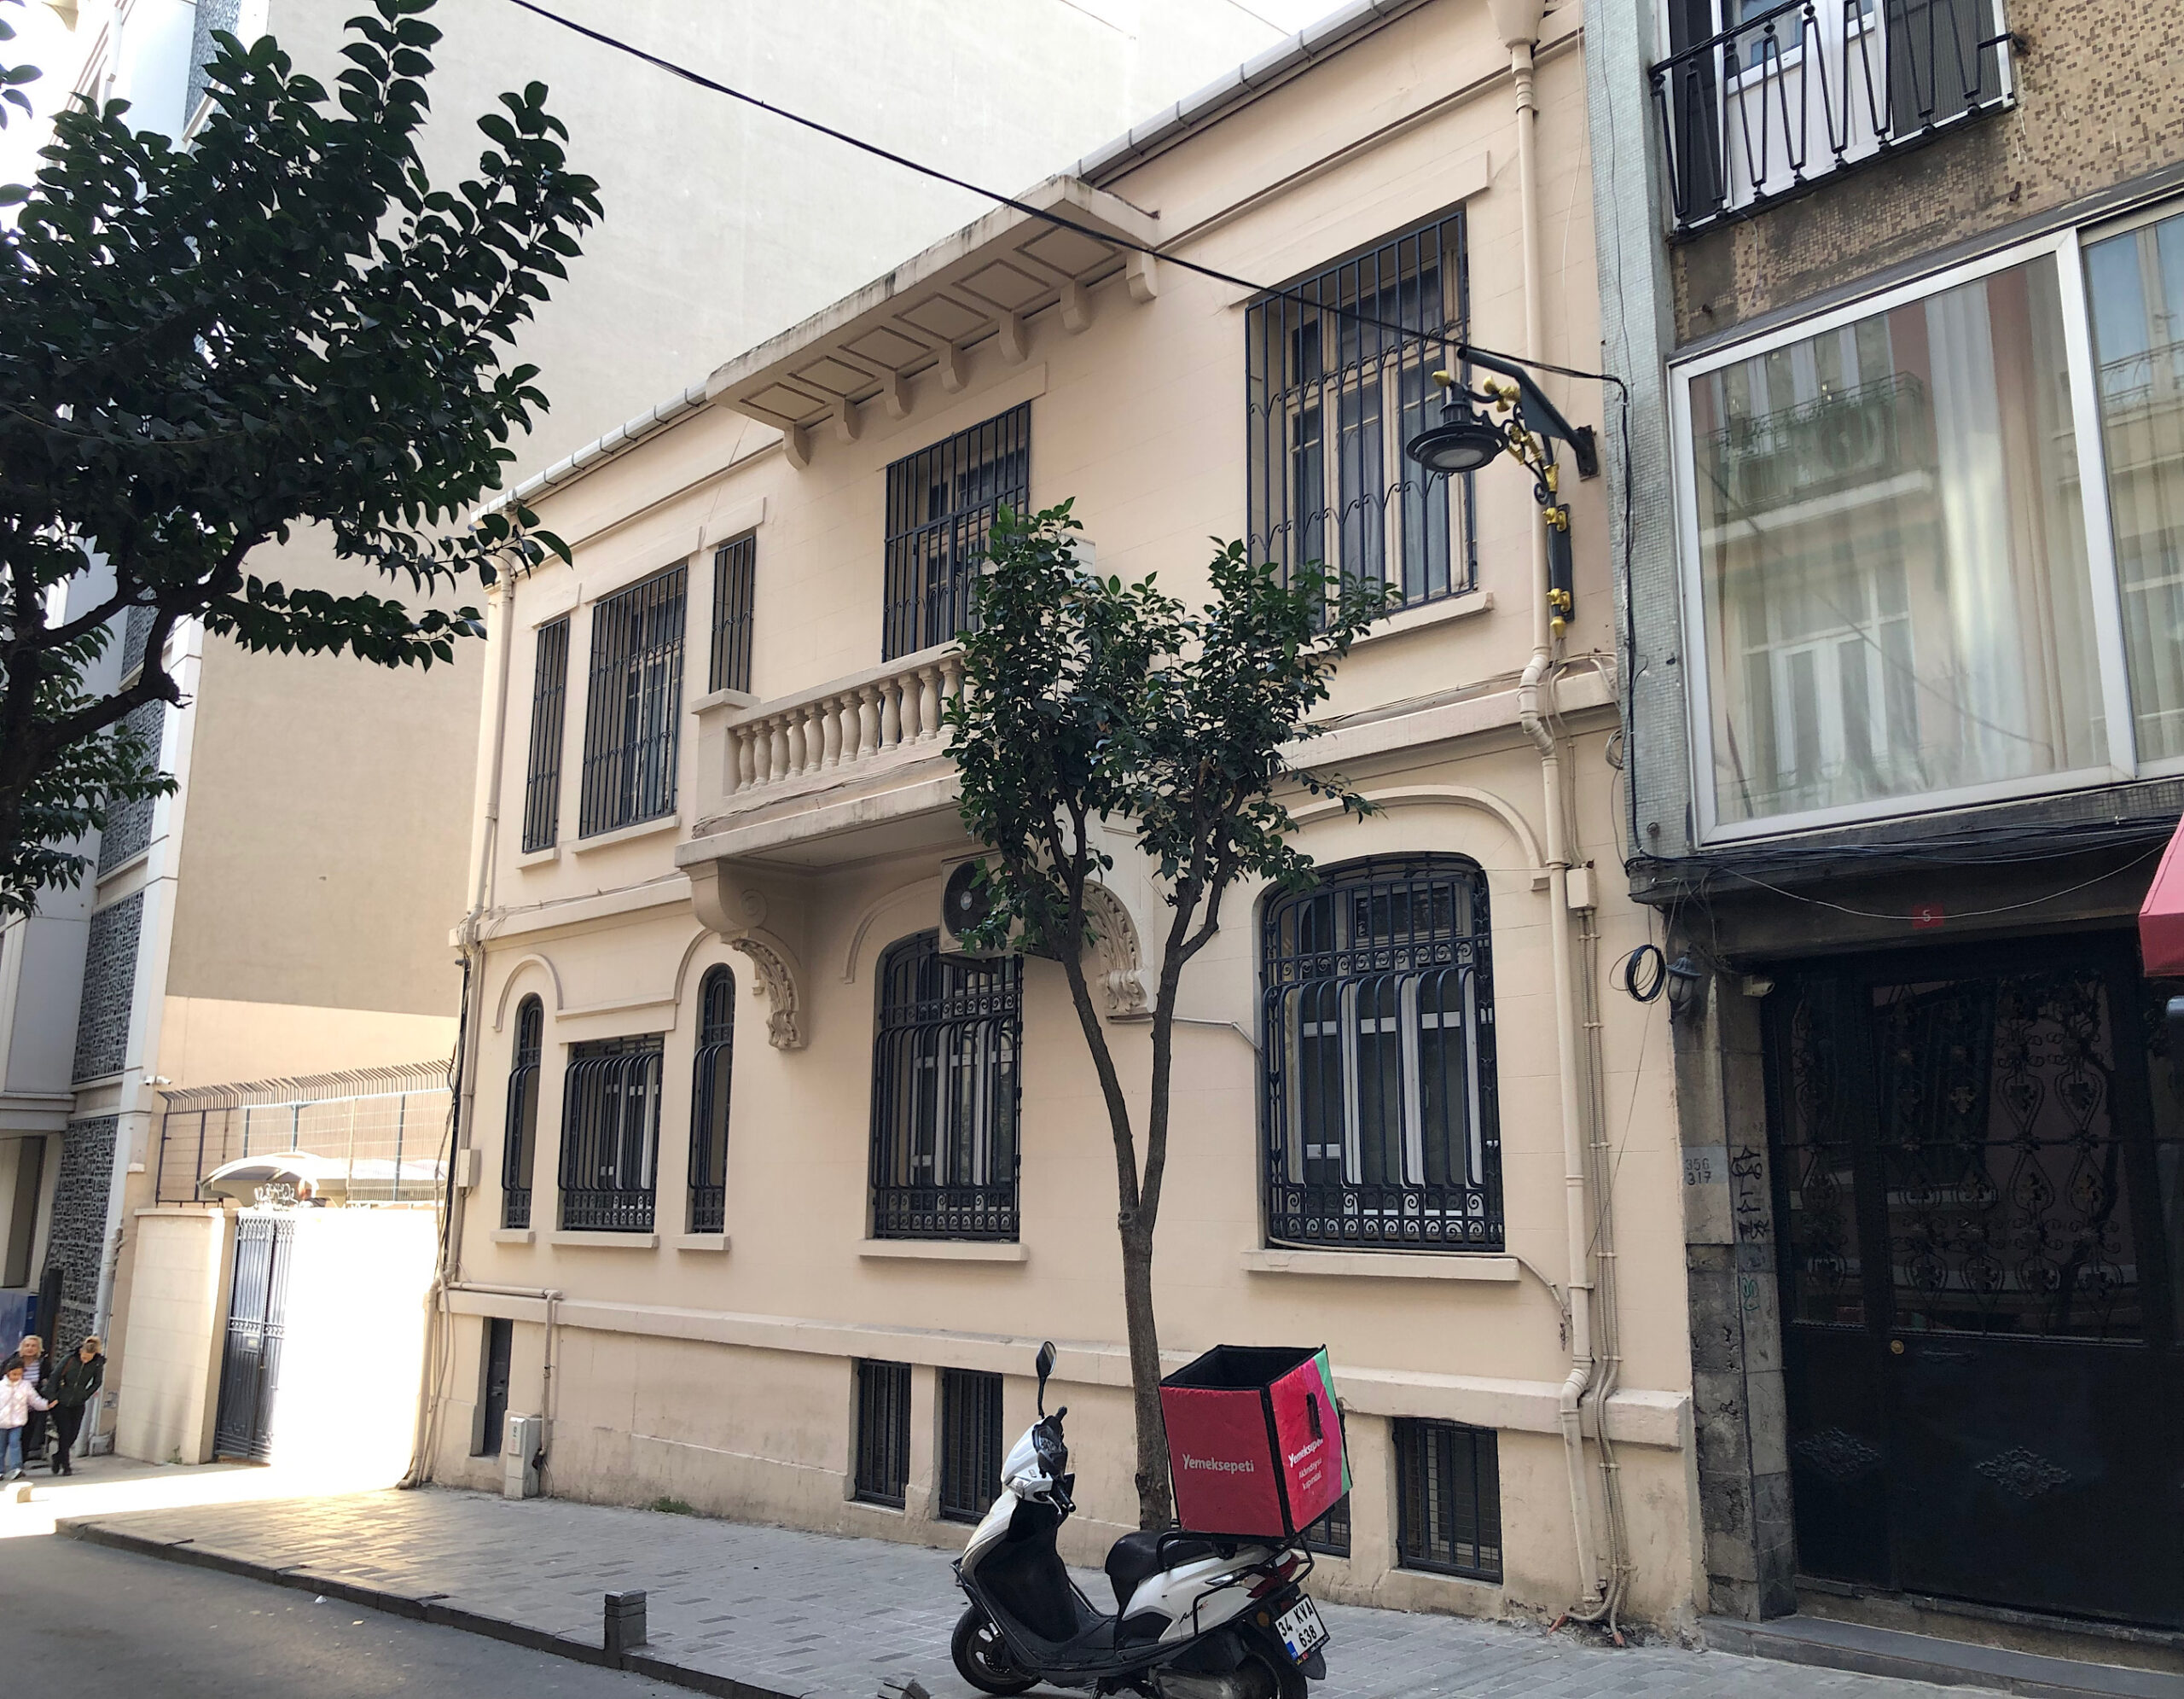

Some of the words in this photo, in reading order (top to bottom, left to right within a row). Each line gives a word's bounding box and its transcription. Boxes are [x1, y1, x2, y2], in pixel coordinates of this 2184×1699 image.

[1922, 909, 1931, 922] 5
[1685, 1157, 1710, 1171] 356
[1687, 1171, 1711, 1185] 317
[1182, 1453, 1255, 1475] Yemeksepeti
[1278, 1616, 1293, 1637] 34
[1293, 1601, 1314, 1625] KVA
[1298, 1625, 1317, 1648] 638
